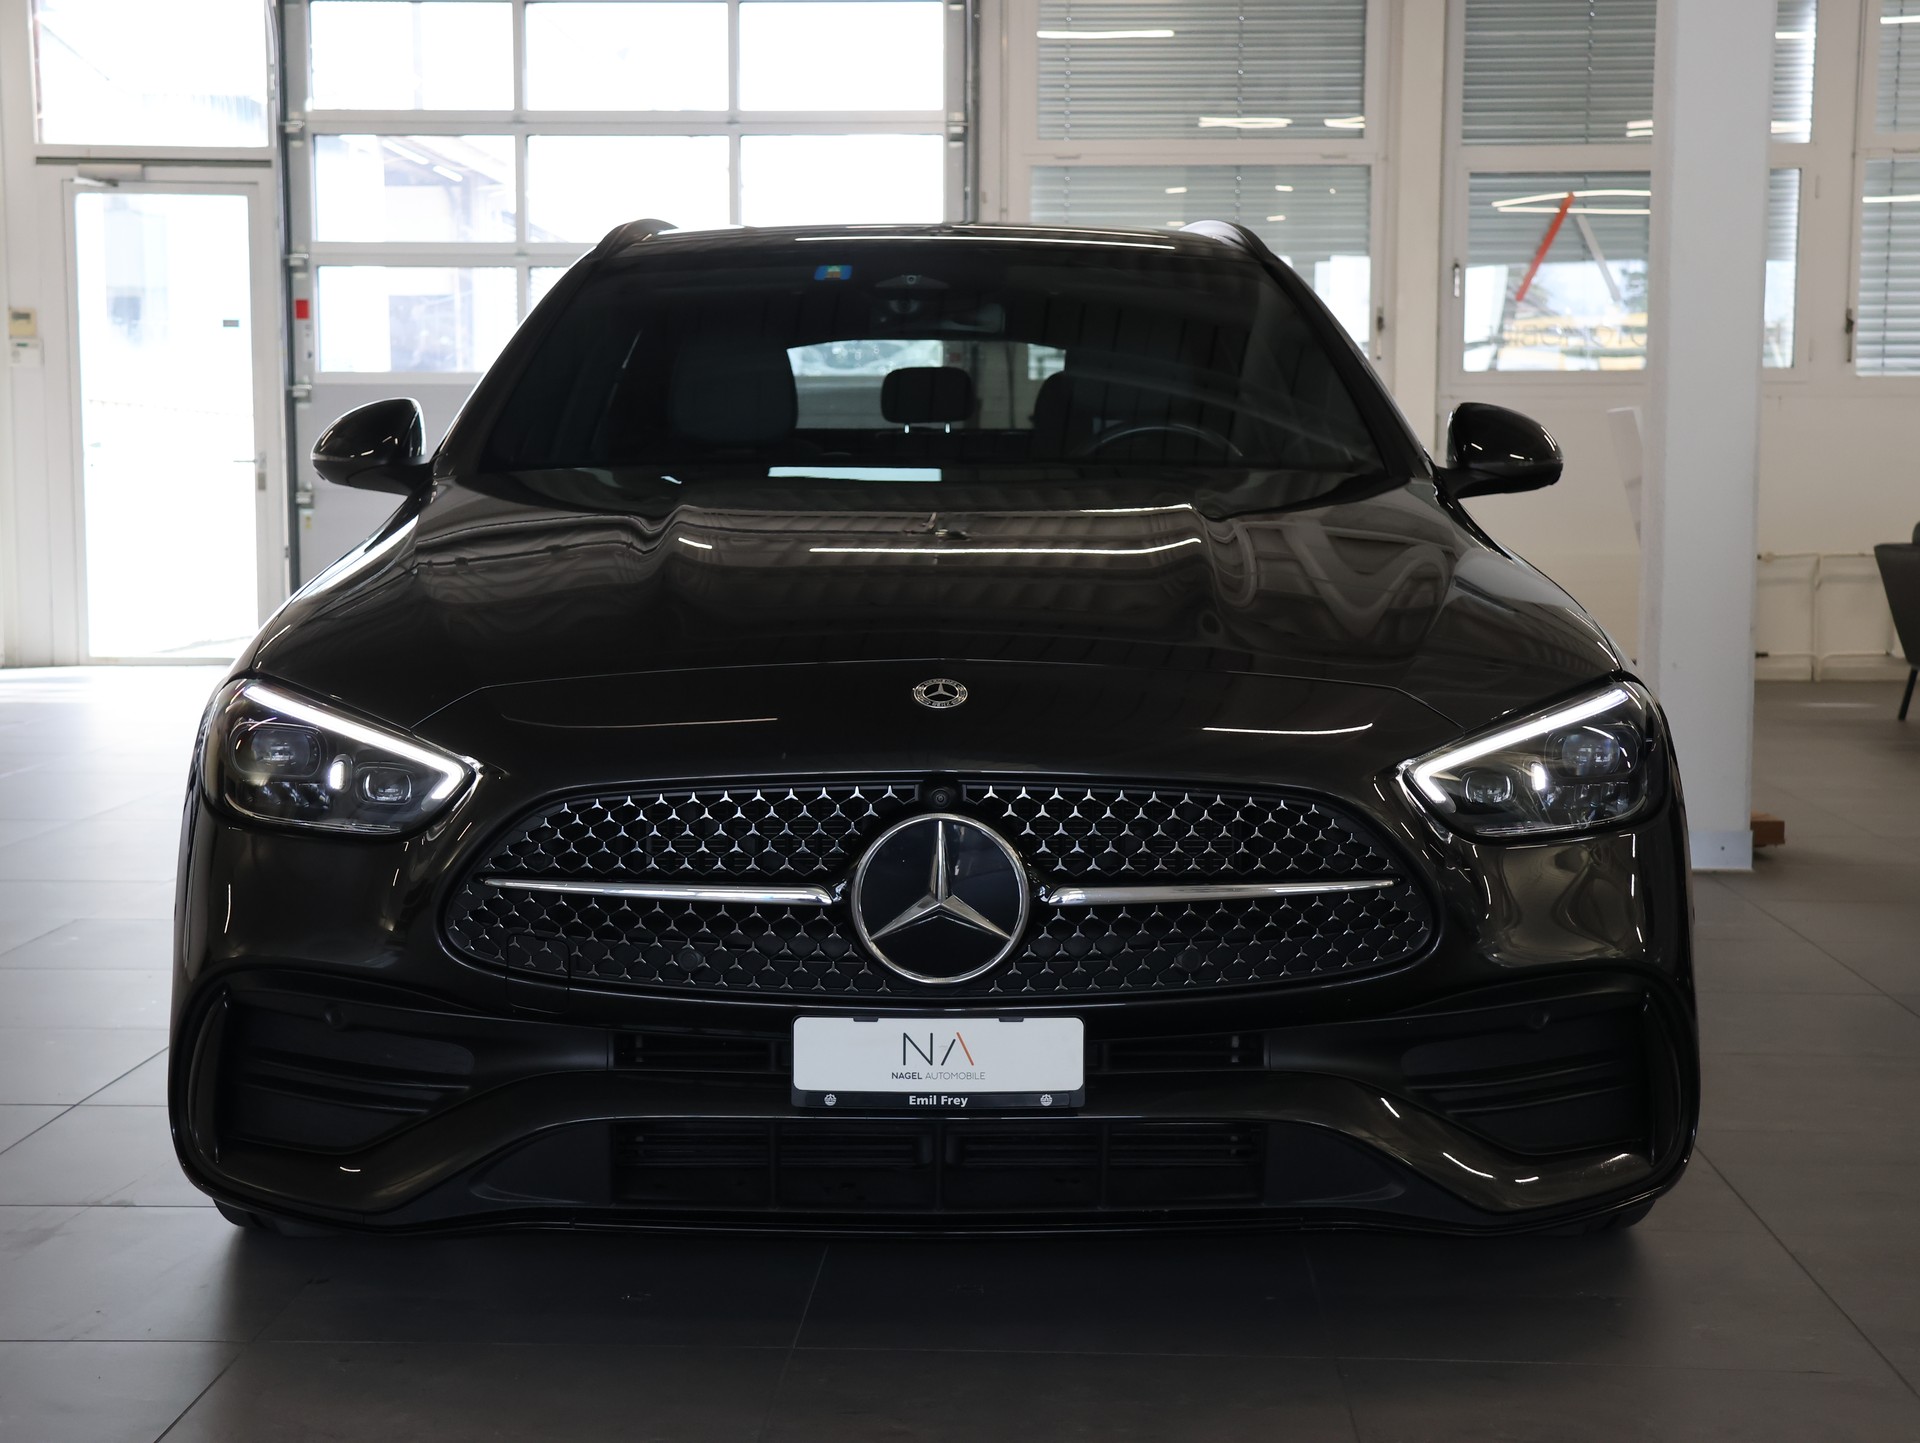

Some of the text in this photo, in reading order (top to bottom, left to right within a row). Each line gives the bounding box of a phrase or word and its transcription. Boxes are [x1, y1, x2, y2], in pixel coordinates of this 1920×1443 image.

[891, 1071, 986, 1080] NAGEL AUTOMOBILE
[909, 1095, 968, 1107] Emil Frey
